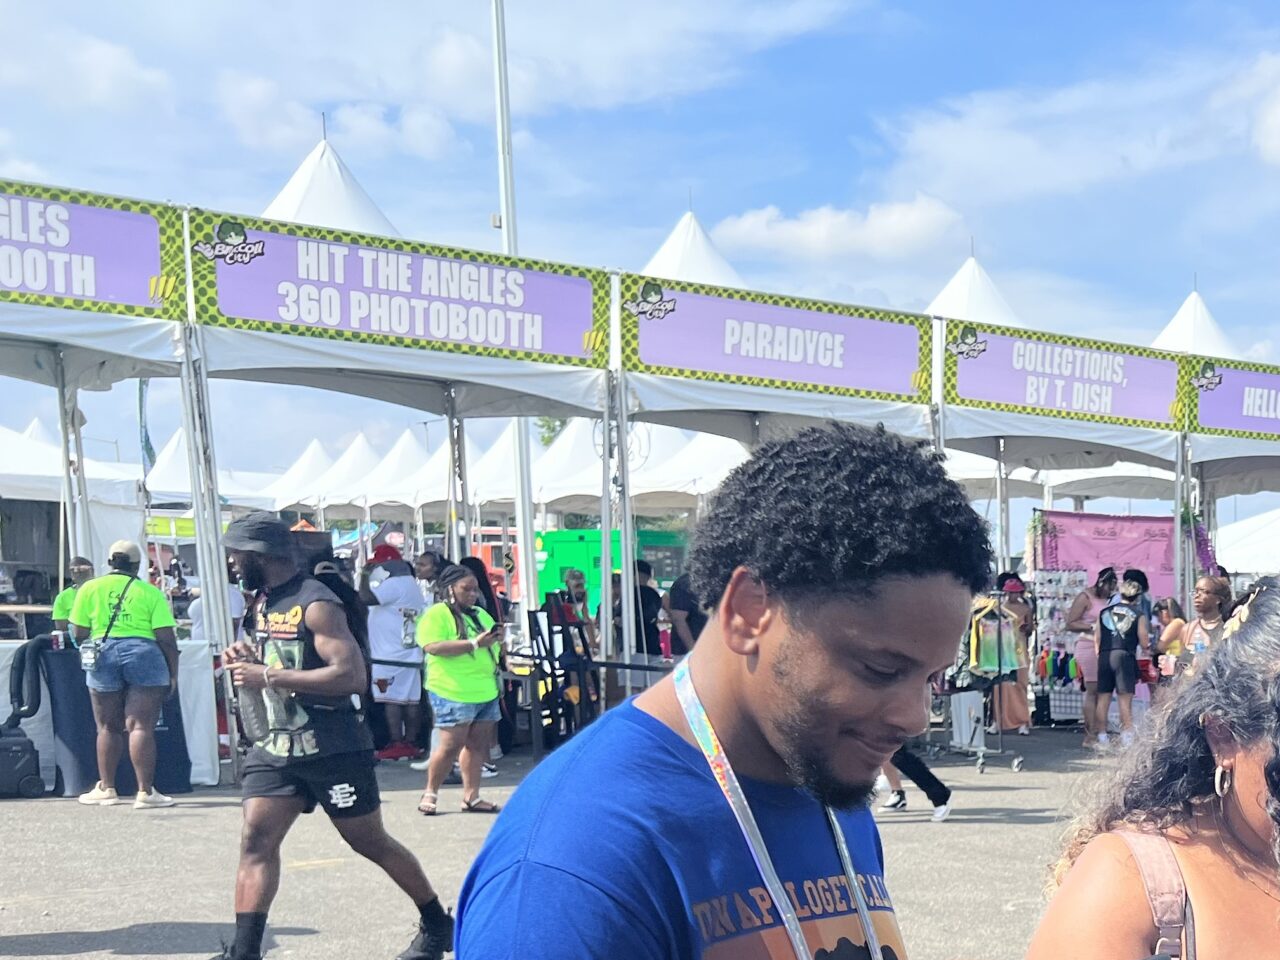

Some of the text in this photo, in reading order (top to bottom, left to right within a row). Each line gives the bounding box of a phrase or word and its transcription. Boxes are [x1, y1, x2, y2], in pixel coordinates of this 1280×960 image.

[297, 239, 524, 308] HIT THE ANGLES
[277, 281, 543, 350] 360 PHOTOBOOTH
[724, 319, 845, 368] PARADYCE
[1012, 341, 1129, 388] COLLECTIONS,
[1026, 375, 1113, 414] BY T. DISH
